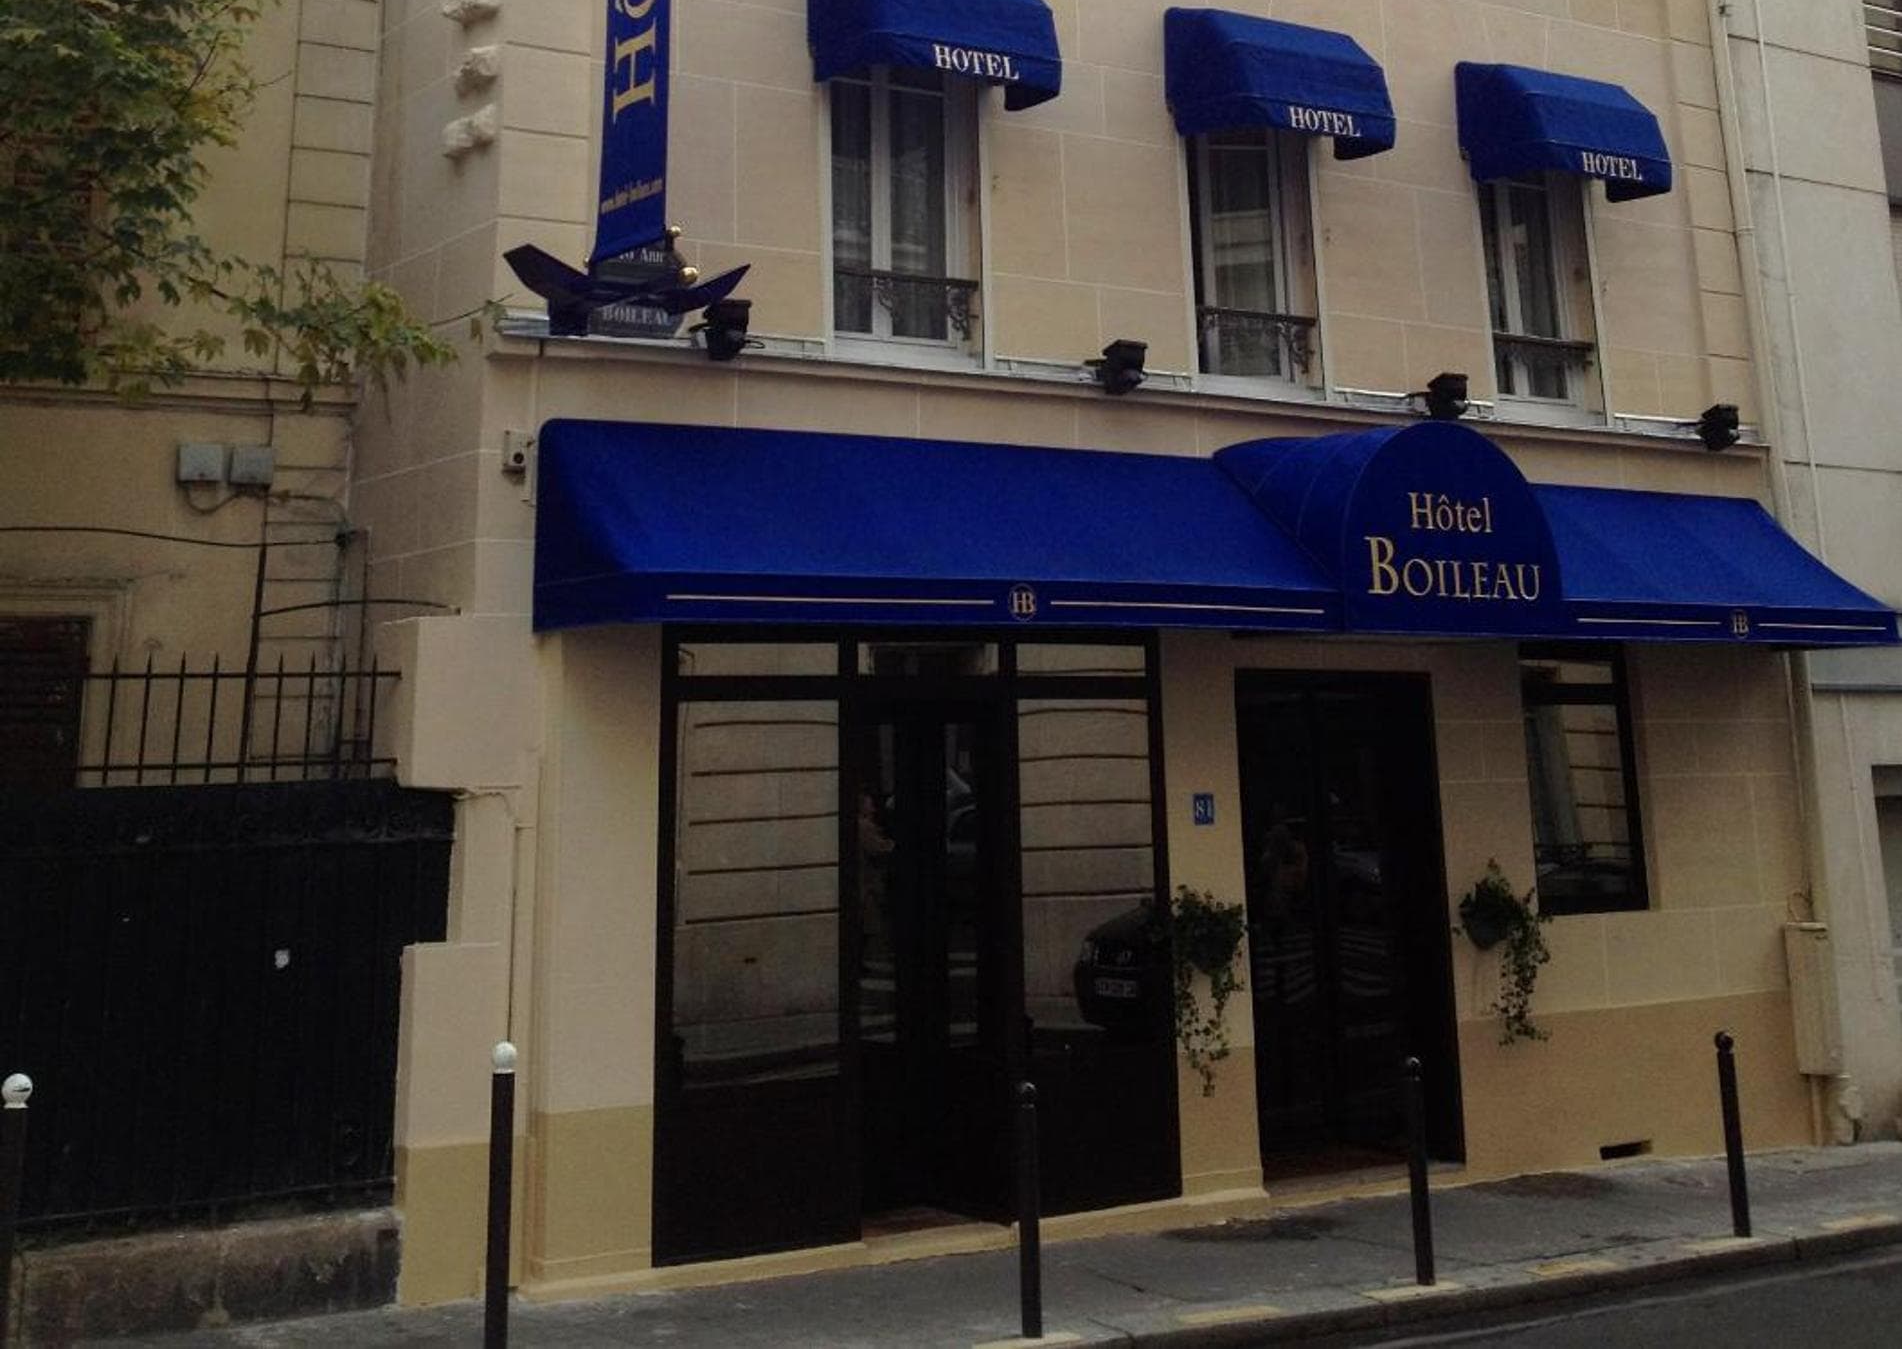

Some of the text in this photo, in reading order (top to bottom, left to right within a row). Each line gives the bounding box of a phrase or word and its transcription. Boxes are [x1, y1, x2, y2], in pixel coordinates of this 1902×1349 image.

[932, 43, 1019, 80] HOTEL
[1288, 105, 1361, 137] HOTEL
[1582, 151, 1642, 180] HOTEL
[1407, 492, 1493, 533] Hôtel
[1364, 536, 1541, 601] BOILEAU
[1013, 592, 1036, 613] HB
